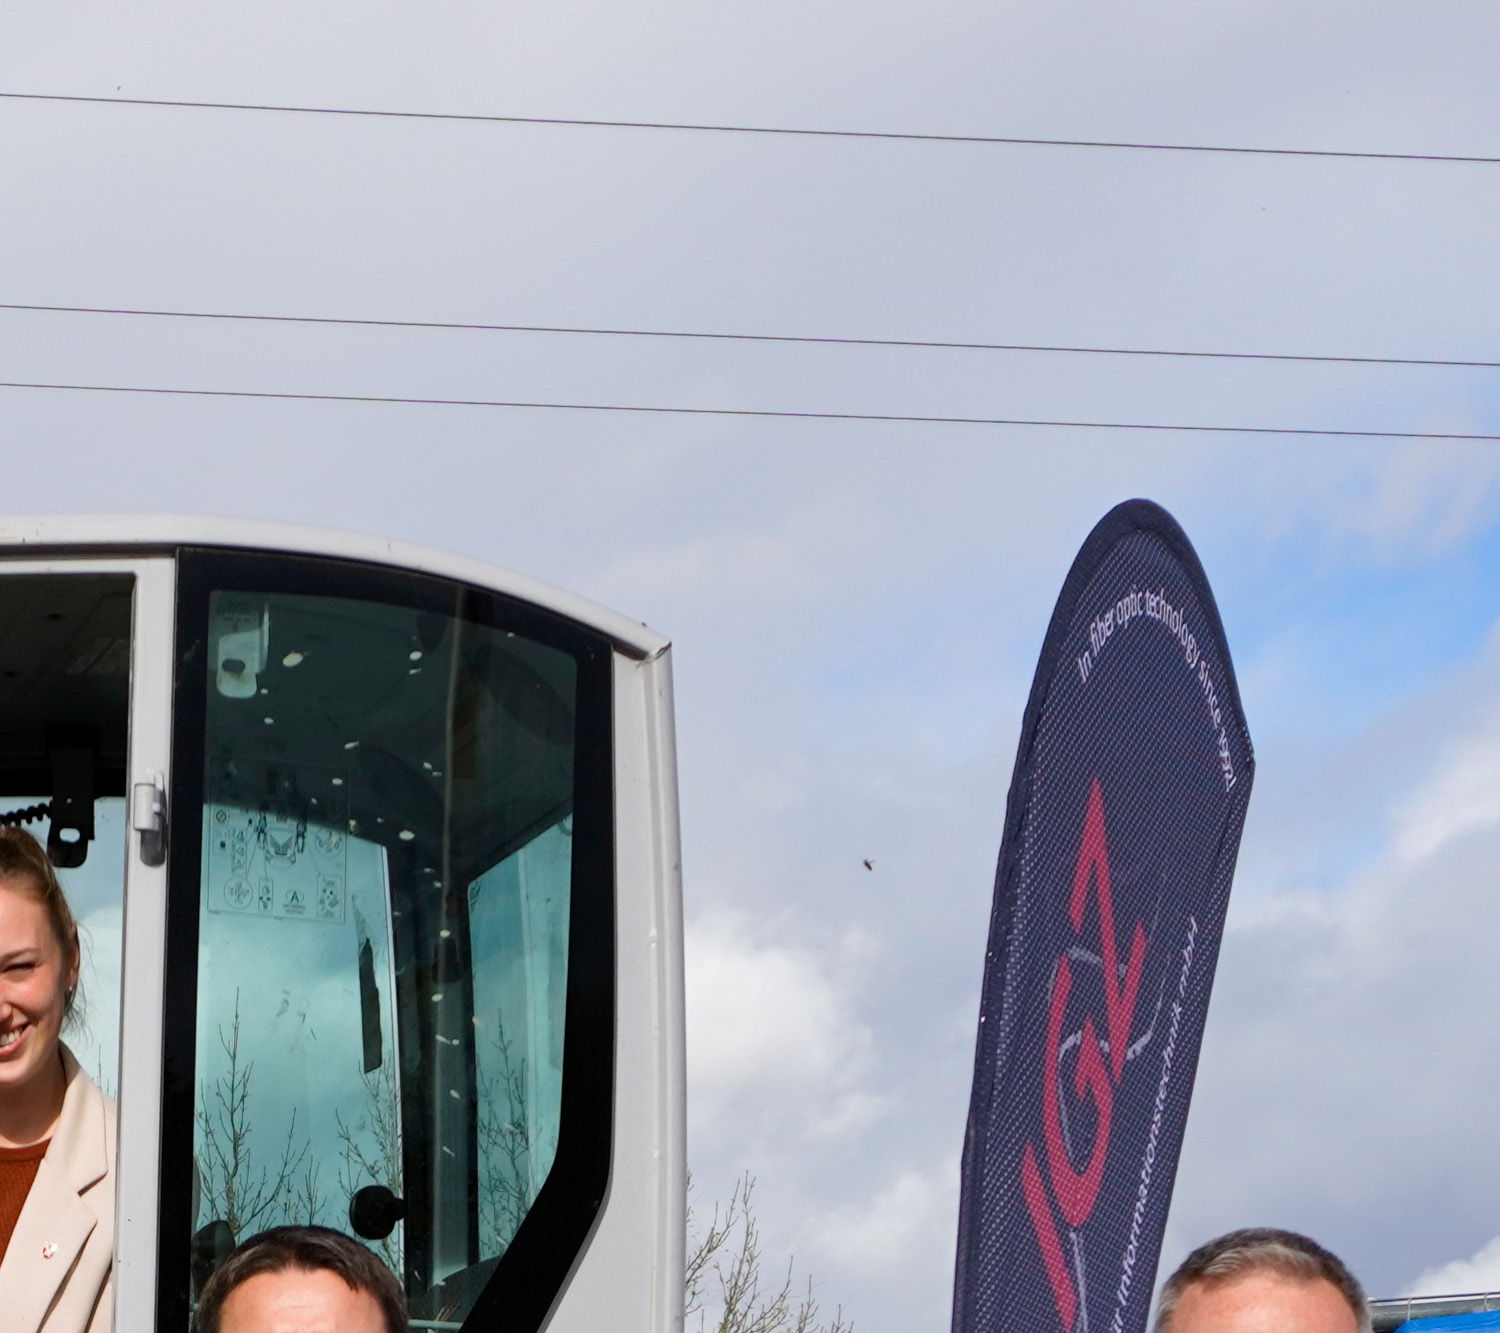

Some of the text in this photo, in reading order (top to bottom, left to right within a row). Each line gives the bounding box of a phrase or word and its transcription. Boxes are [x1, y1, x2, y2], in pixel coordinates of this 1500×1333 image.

[1089, 613, 1116, 657] fiber
[1116, 590, 1144, 628] optic
[1145, 588, 1199, 668] technology
[1116, 1001, 1184, 1310] Informationstechnik
[1178, 915, 1199, 997] mbH
